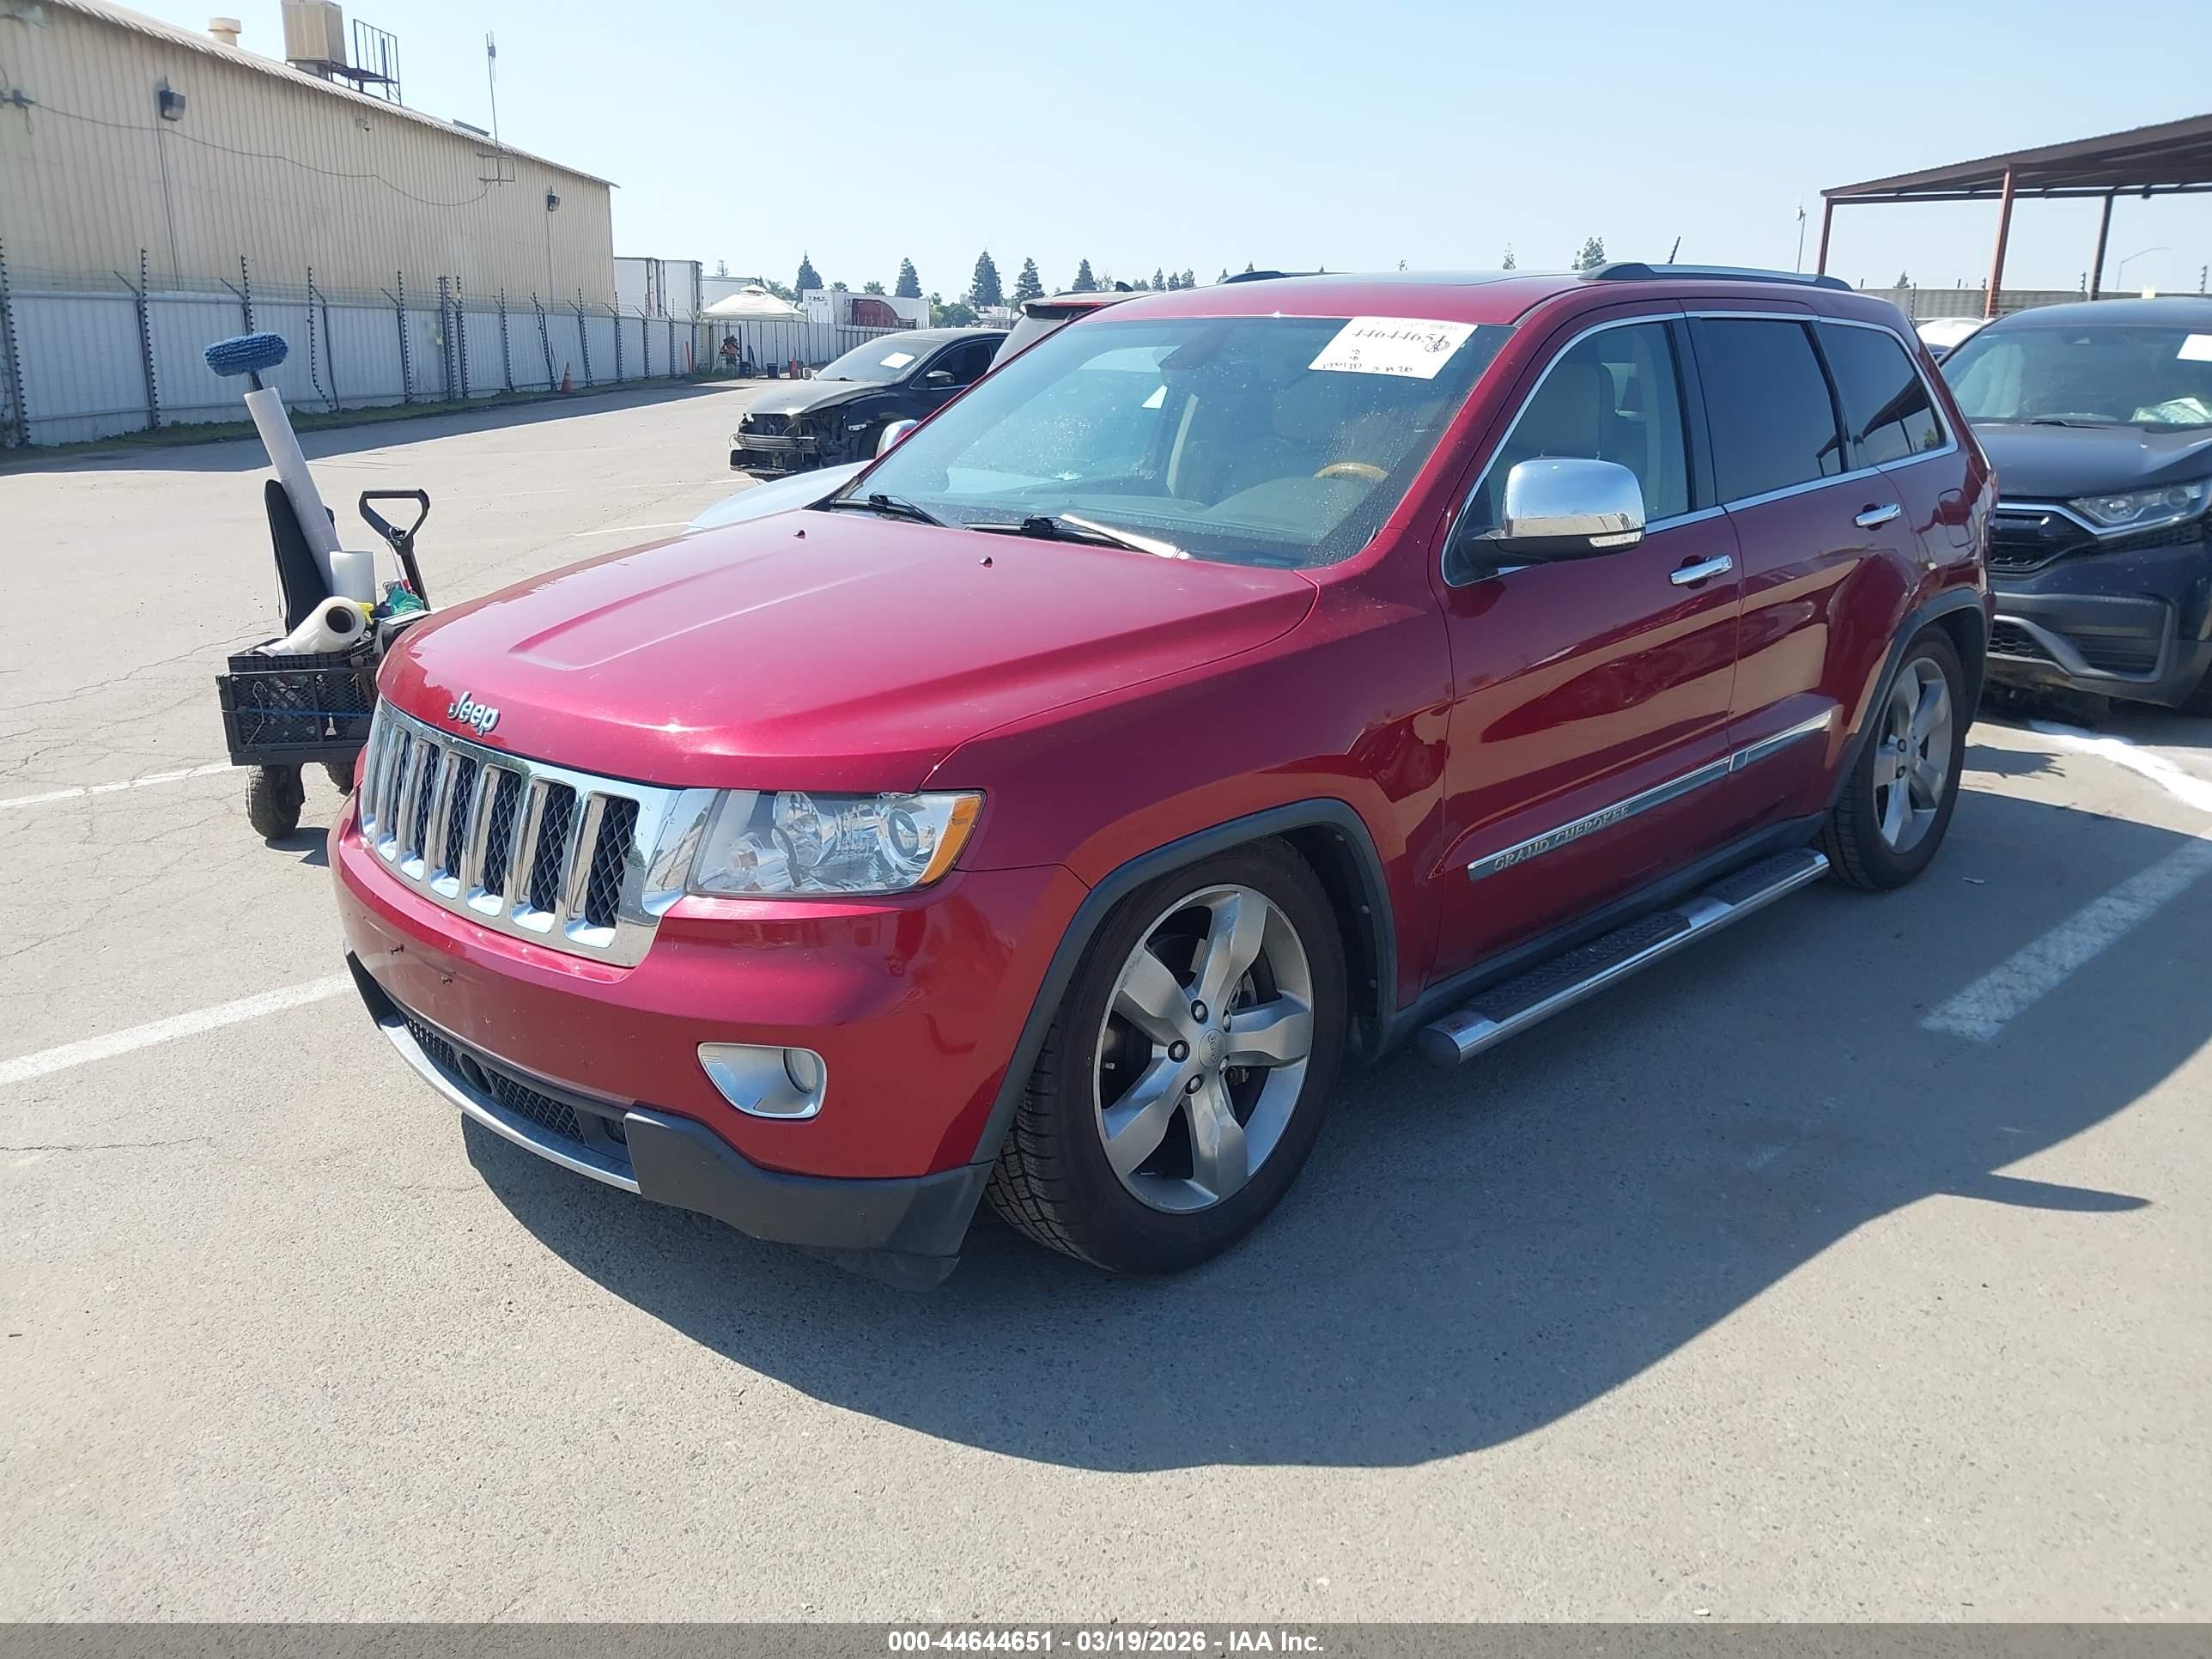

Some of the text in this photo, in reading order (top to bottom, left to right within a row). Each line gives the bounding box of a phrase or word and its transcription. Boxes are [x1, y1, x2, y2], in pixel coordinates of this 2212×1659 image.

[447, 690, 501, 738] Jeep
[1493, 805, 1630, 872] GRAND CHEROKEE
